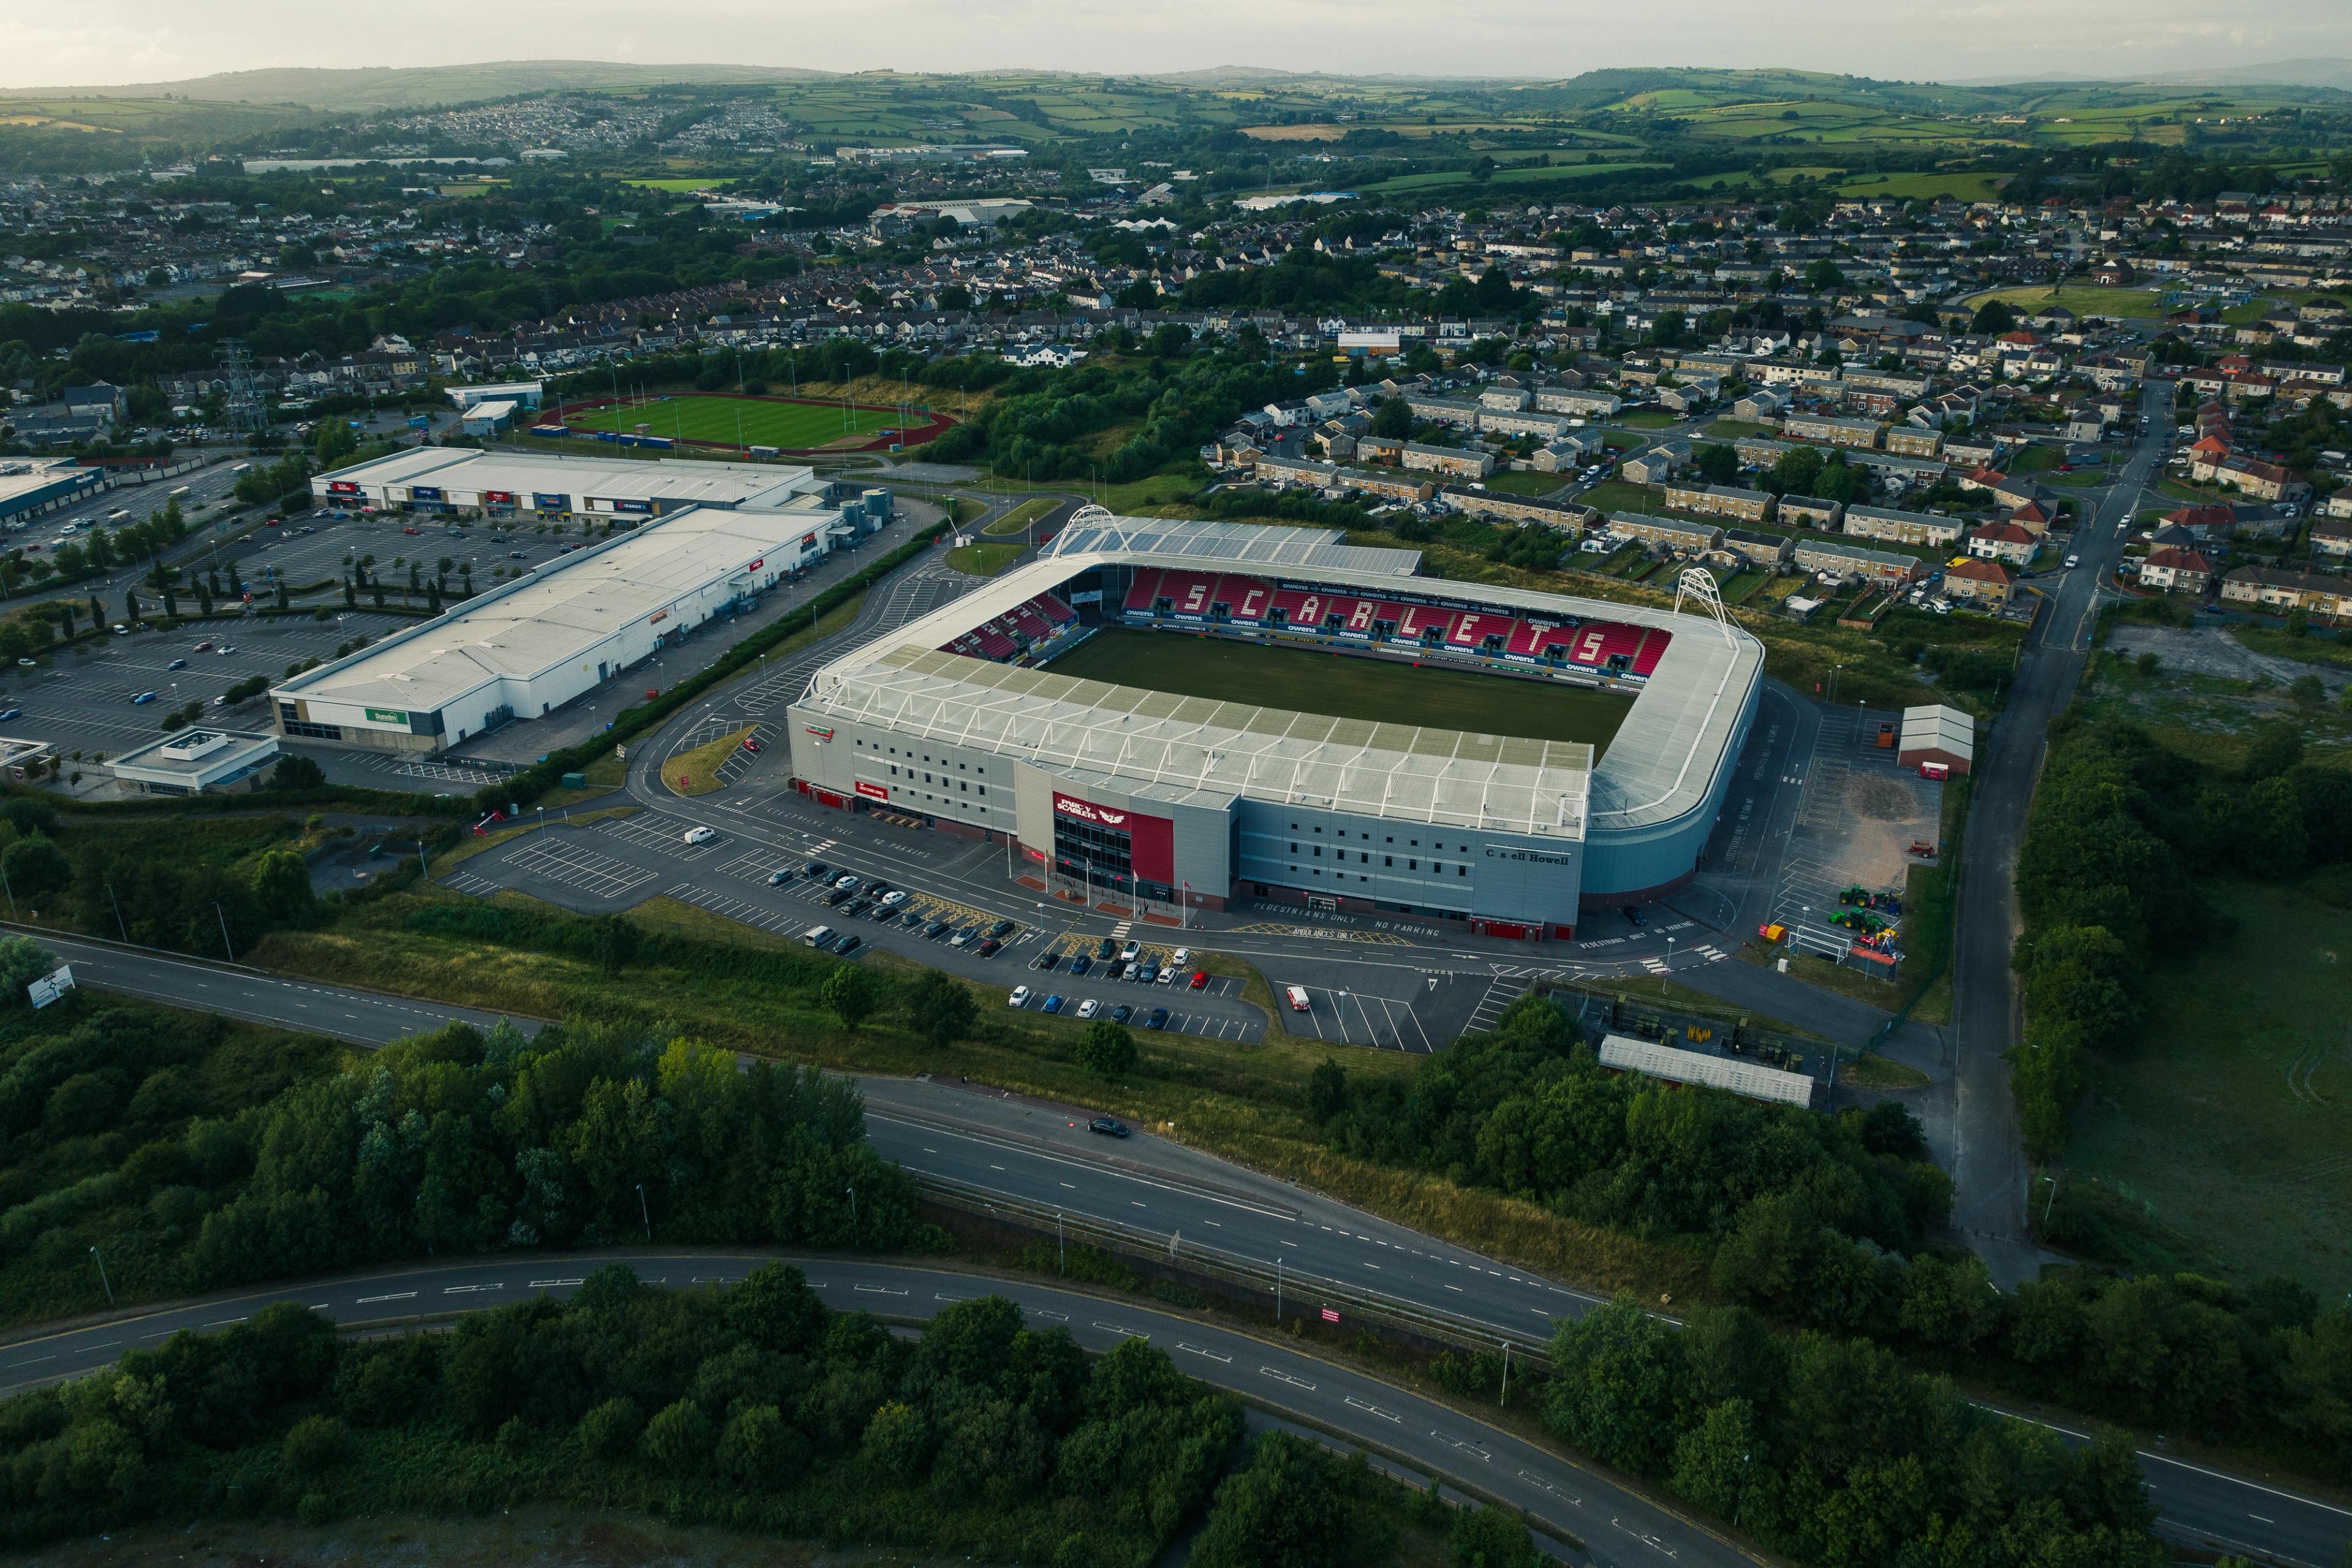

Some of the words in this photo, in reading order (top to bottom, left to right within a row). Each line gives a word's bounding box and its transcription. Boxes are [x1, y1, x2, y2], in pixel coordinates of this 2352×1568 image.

[1074, 593, 1099, 601] STERLING
[1482, 606, 1509, 615] owens
[1231, 619, 1259, 627] owens
[1528, 618, 1561, 628] owens
[1287, 625, 1317, 633] owens
[1340, 631, 1369, 639] owens
[1391, 638, 1420, 647] owens
[1444, 645, 1474, 654] owens
[1504, 654, 1536, 664] owens
[1566, 664, 1598, 674] owens
[1621, 673, 1649, 683] owen
[1061, 799, 1084, 810] PARC
[1057, 803, 1097, 820] SCARLETS
[888, 842, 930, 859] PARKING
[1529, 854, 1569, 865] Howell
[1254, 902, 1326, 919] PEDESTRIANS
[1331, 914, 1357, 924] ONLY
[1374, 921, 1388, 929] NO
[1393, 923, 1439, 937] PARKING
[1293, 929, 1334, 939] AMBULANCES
[1337, 932, 1355, 940] ONLY
[1580, 937, 1626, 949] PEDESTRIANS
[1629, 932, 1647, 940] ONLY
[1666, 921, 1694, 932] PARKING
